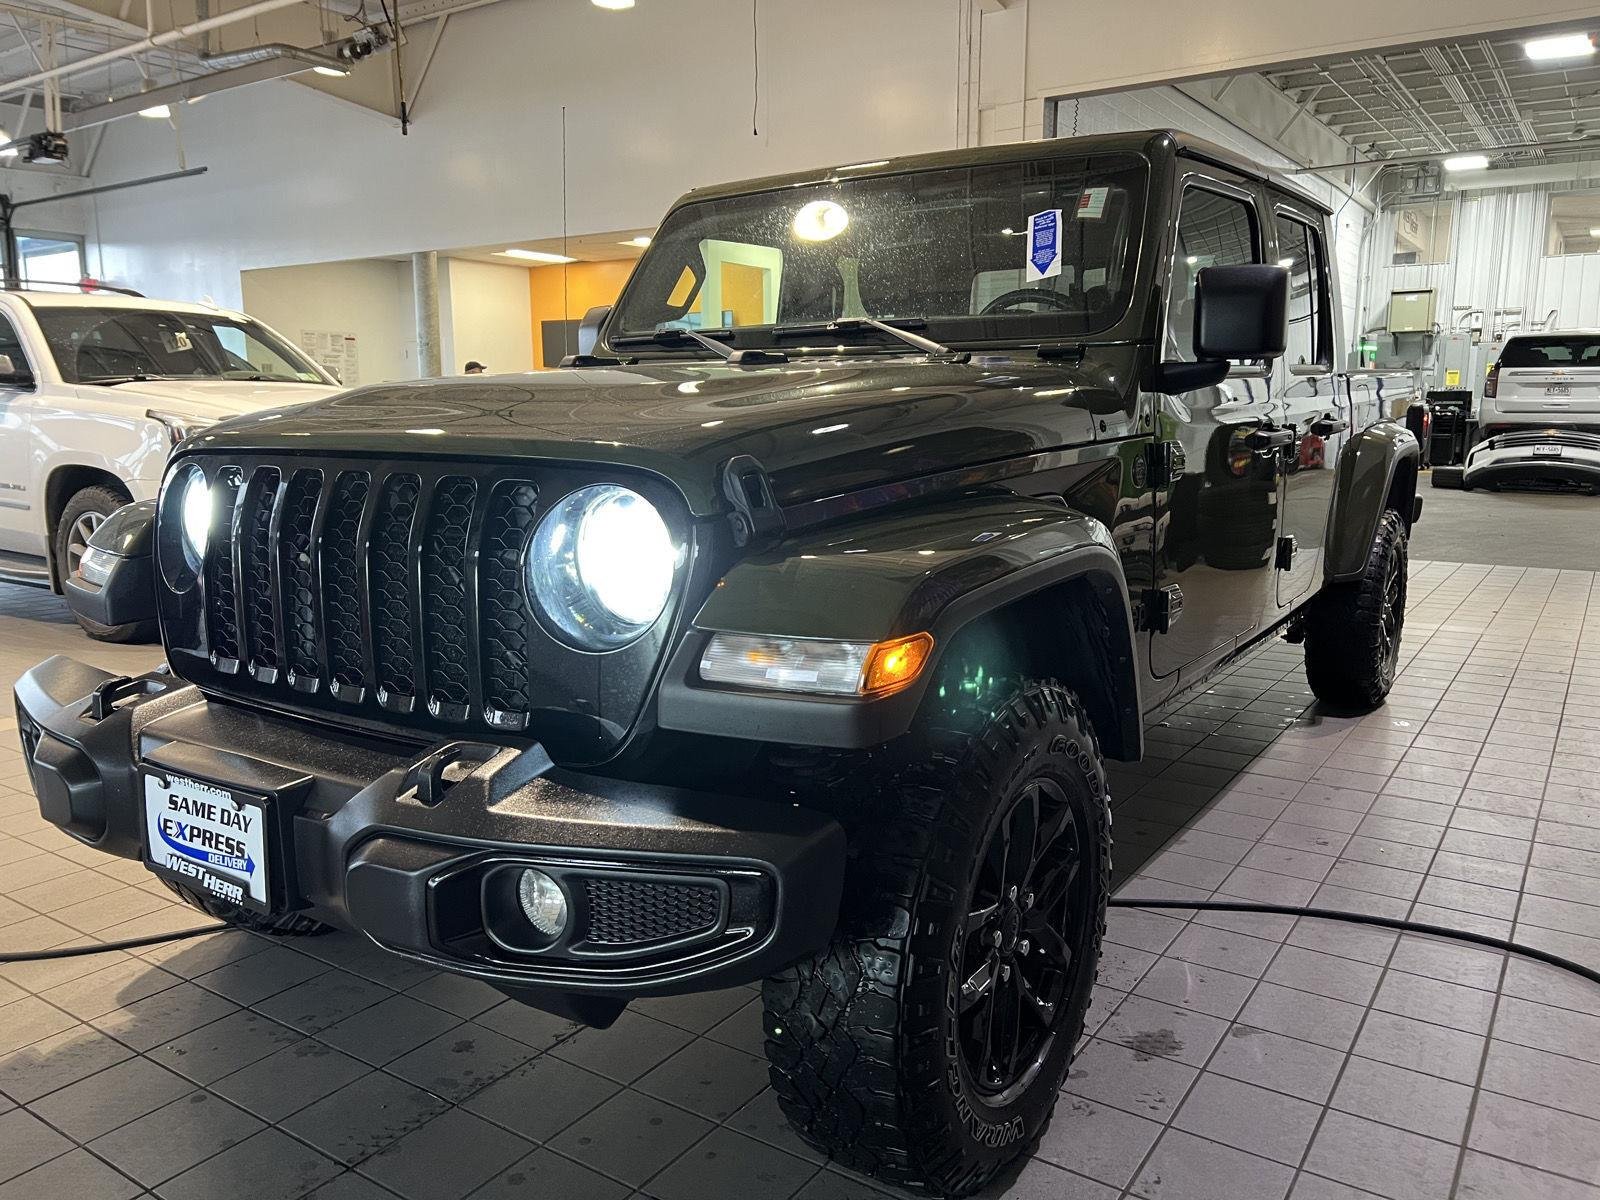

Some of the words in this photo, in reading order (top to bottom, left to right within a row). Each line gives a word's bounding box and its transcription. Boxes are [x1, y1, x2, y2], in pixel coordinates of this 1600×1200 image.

[165, 774, 232, 799] westherr.com
[168, 794, 217, 821] SAME
[219, 808, 253, 833] DAY
[163, 818, 246, 857] EXPRESS
[165, 853, 206, 879] WEST
[203, 874, 244, 900] HERR
[207, 853, 247, 871] DELIVERY
